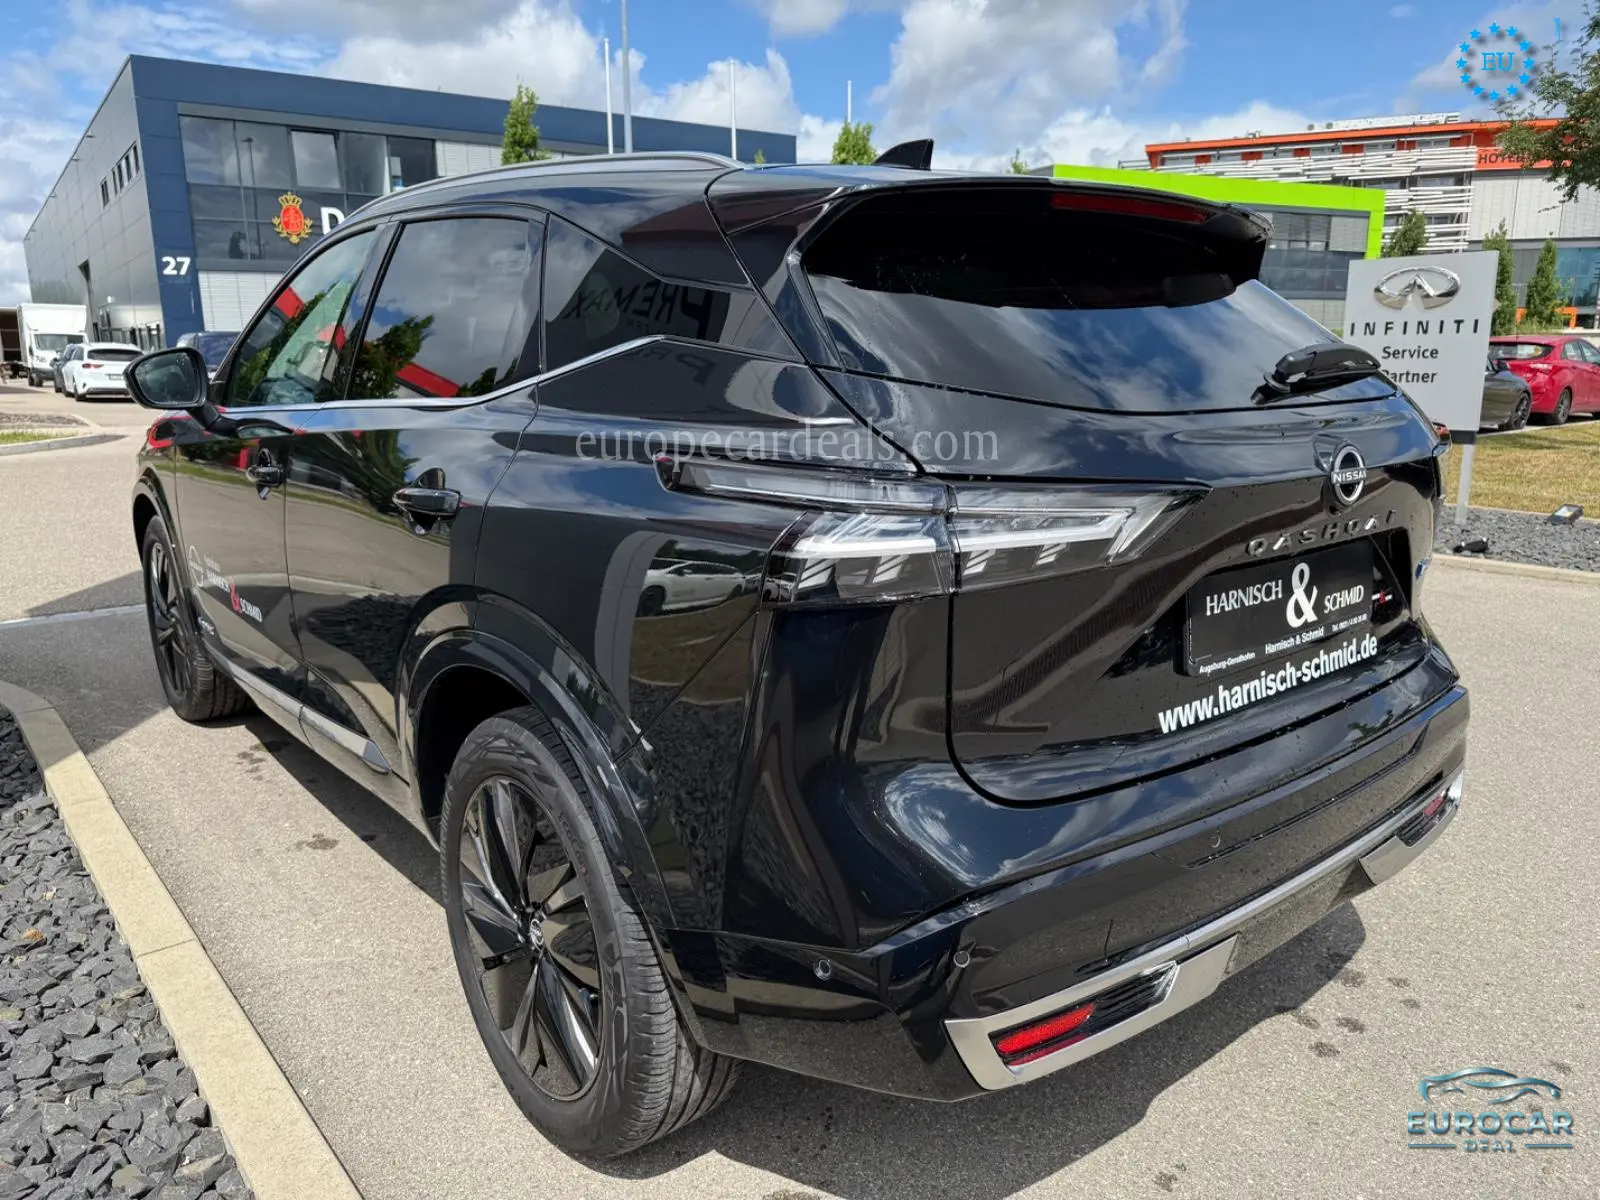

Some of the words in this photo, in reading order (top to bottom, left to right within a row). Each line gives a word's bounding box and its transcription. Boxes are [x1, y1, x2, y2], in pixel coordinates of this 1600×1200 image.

[162, 256, 191, 276] 27
[1350, 319, 1479, 336] INFINITI
[1382, 345, 1439, 360] Service
[1206, 579, 1283, 616] HARNISCH
[1286, 562, 1319, 628] &
[1324, 584, 1364, 614] SCHMID
[1265, 637, 1295, 655] Harnisch
[1301, 625, 1325, 643] Schmid
[1157, 632, 1378, 735] www.harnisch-schmid.de
